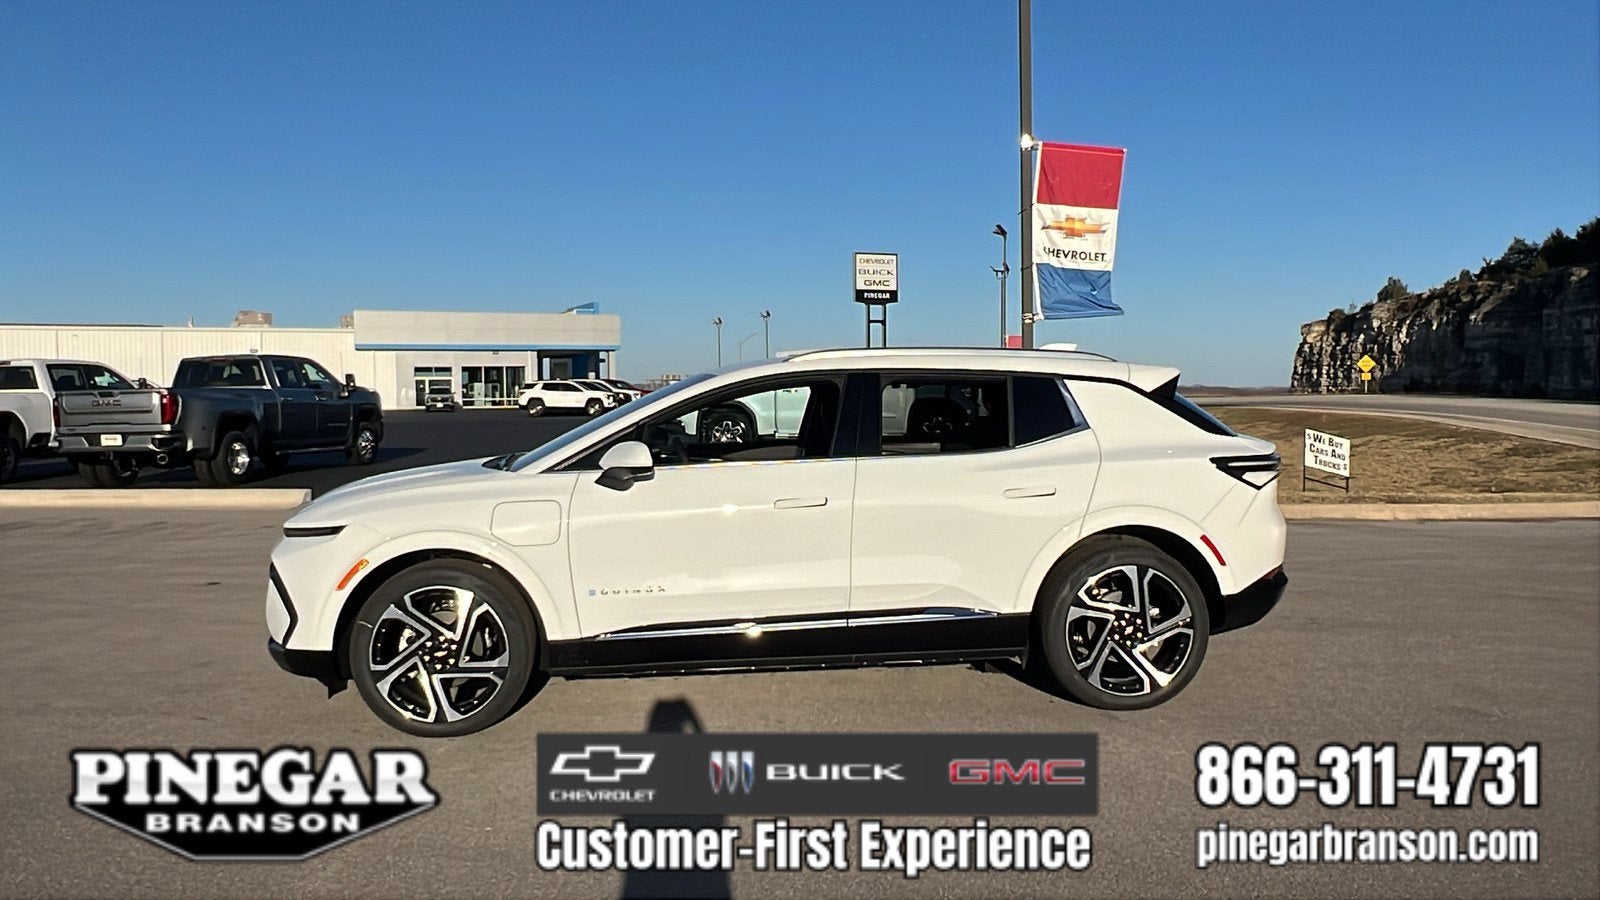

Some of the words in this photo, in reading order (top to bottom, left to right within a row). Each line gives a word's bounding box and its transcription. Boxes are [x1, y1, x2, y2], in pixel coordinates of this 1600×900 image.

[858, 257, 894, 265] CHEVROLET
[863, 279, 890, 287] GMC
[91, 399, 122, 407] GMC
